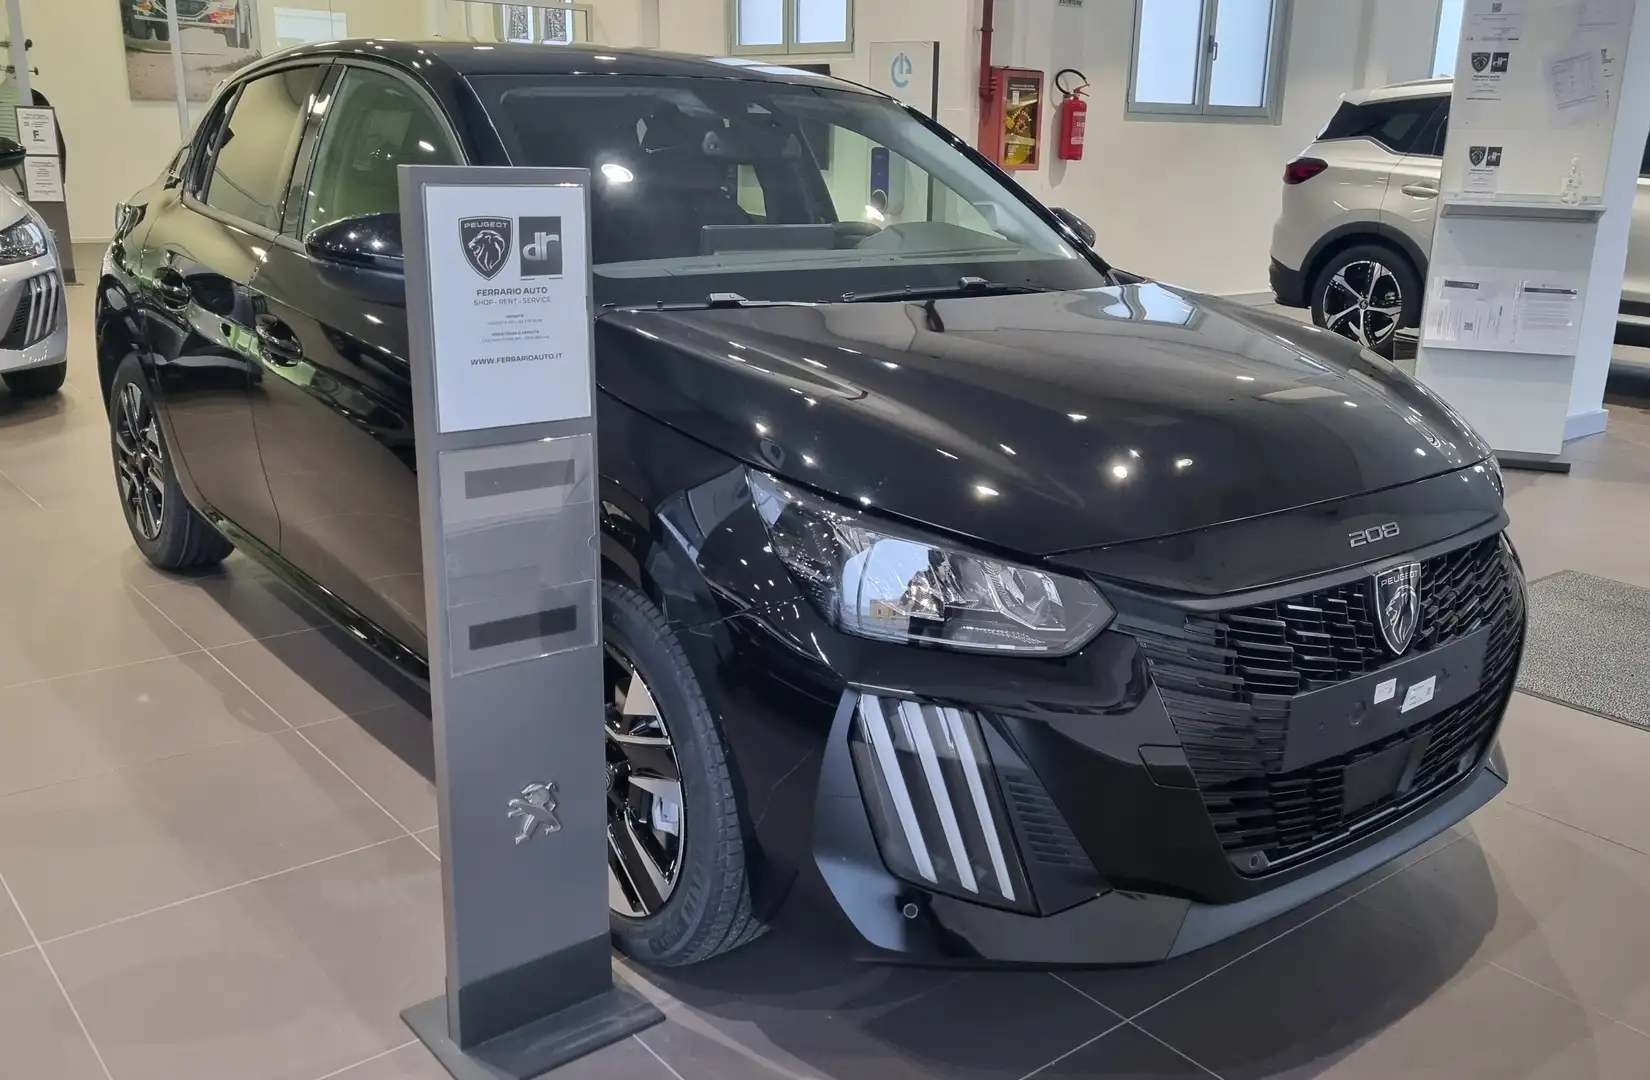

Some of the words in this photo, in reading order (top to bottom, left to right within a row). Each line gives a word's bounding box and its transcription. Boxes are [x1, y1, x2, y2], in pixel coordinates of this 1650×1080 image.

[463, 221, 509, 229] PEUGEOT
[522, 231, 560, 262] dr
[476, 287, 522, 297] FERRARIO
[523, 286, 548, 295] AUTO
[522, 296, 551, 304] SERVICE
[470, 353, 564, 366] WWW.FERRARIOAUTO.IT
[1348, 521, 1400, 548] 208
[1380, 570, 1419, 588] PEUGEOT
